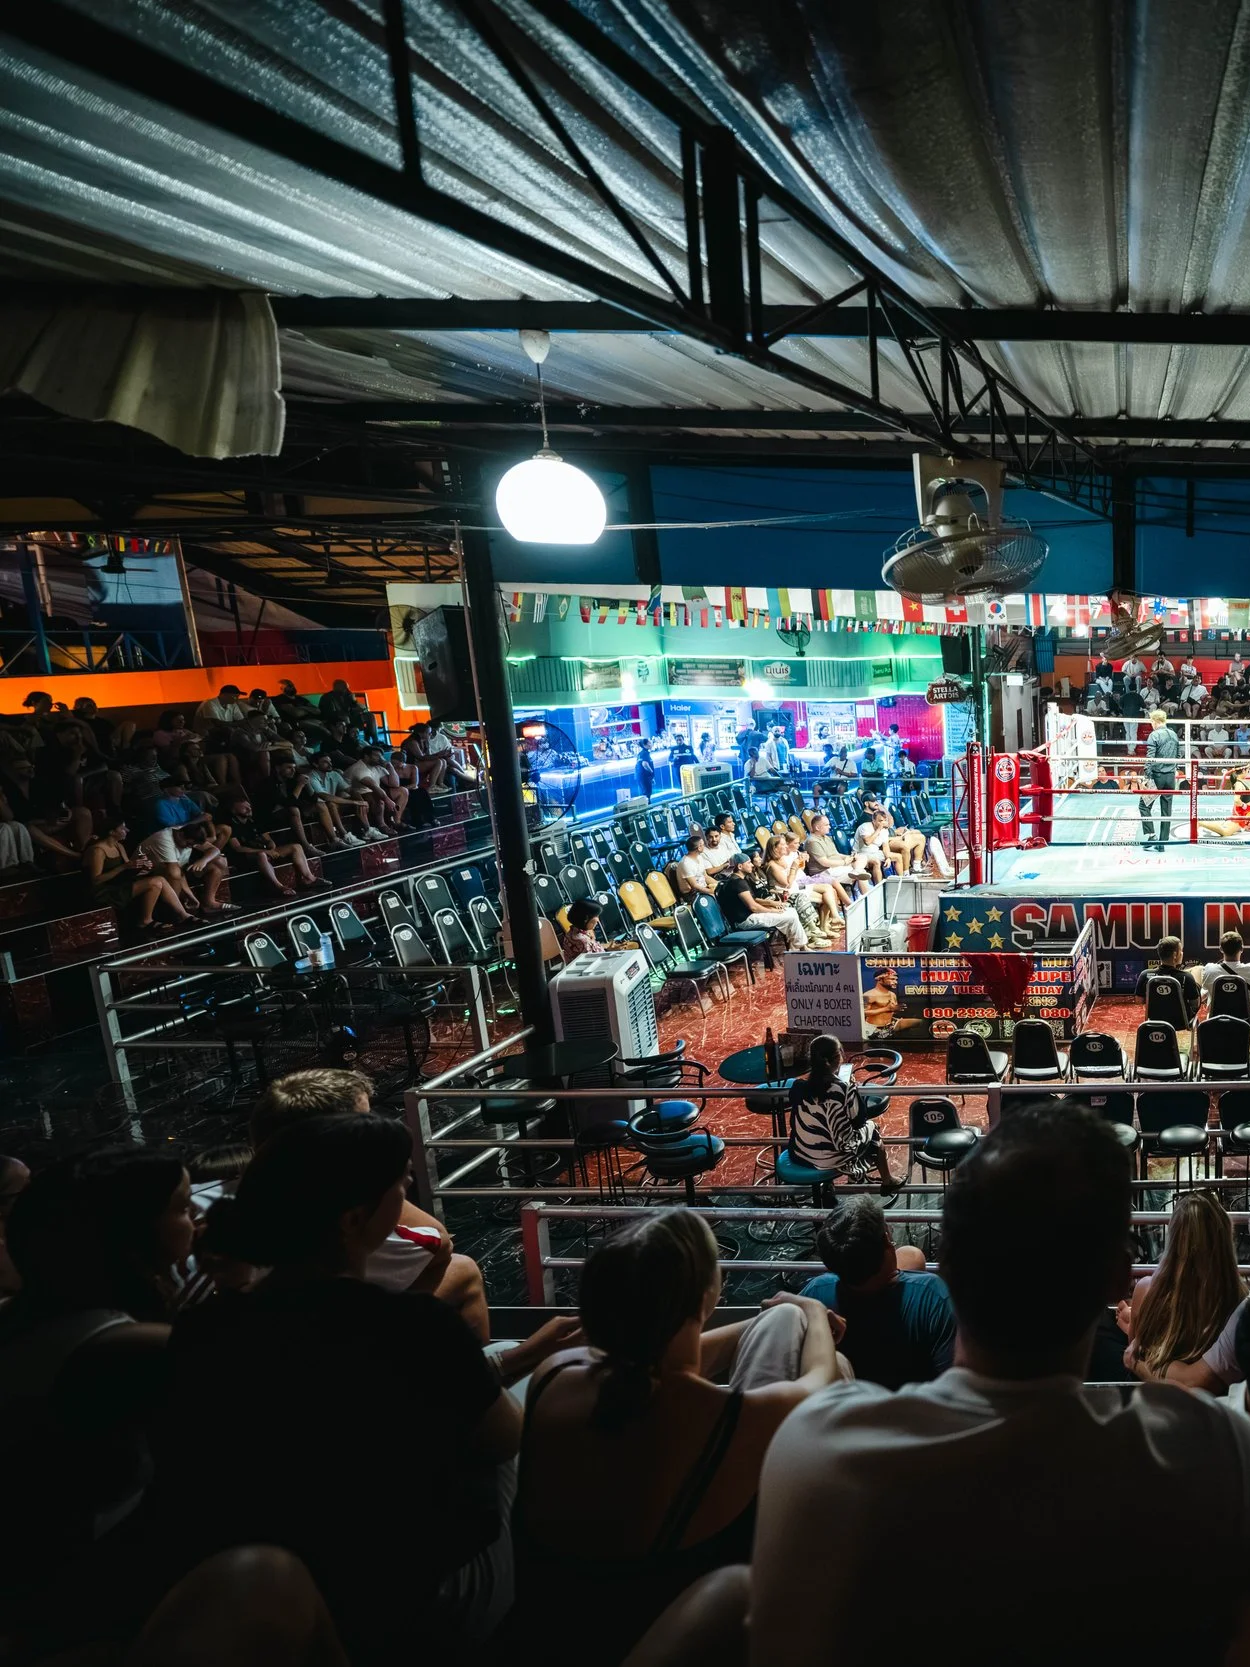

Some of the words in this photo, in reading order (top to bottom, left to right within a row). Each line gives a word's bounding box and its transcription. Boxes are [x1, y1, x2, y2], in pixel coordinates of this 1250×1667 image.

[932, 686, 958, 694] STELLA
[932, 692, 959, 700] ARTOIS
[670, 703, 691, 711] Haier
[300, 923, 309, 932] 87
[1010, 902, 1184, 950] SAMUI
[865, 957, 915, 968] SAMUI
[798, 962, 840, 976] เฉพาะ
[921, 971, 972, 982] MUAY
[836, 982, 841, 992] 4
[905, 985, 948, 995] EVERY
[1023, 985, 1064, 995] RIDAY
[1158, 986, 1169, 994] 91
[1224, 983, 1236, 991] 92
[791, 999, 813, 1009] ONLY
[816, 999, 821, 1009] 4
[824, 999, 852, 1010] BOXER
[794, 1015, 852, 1027] CHAPERONES
[1150, 1033, 1166, 1041] 104
[957, 1039, 974, 1047] 101
[1087, 1042, 1103, 1051] 103
[924, 1112, 944, 1122] 105
